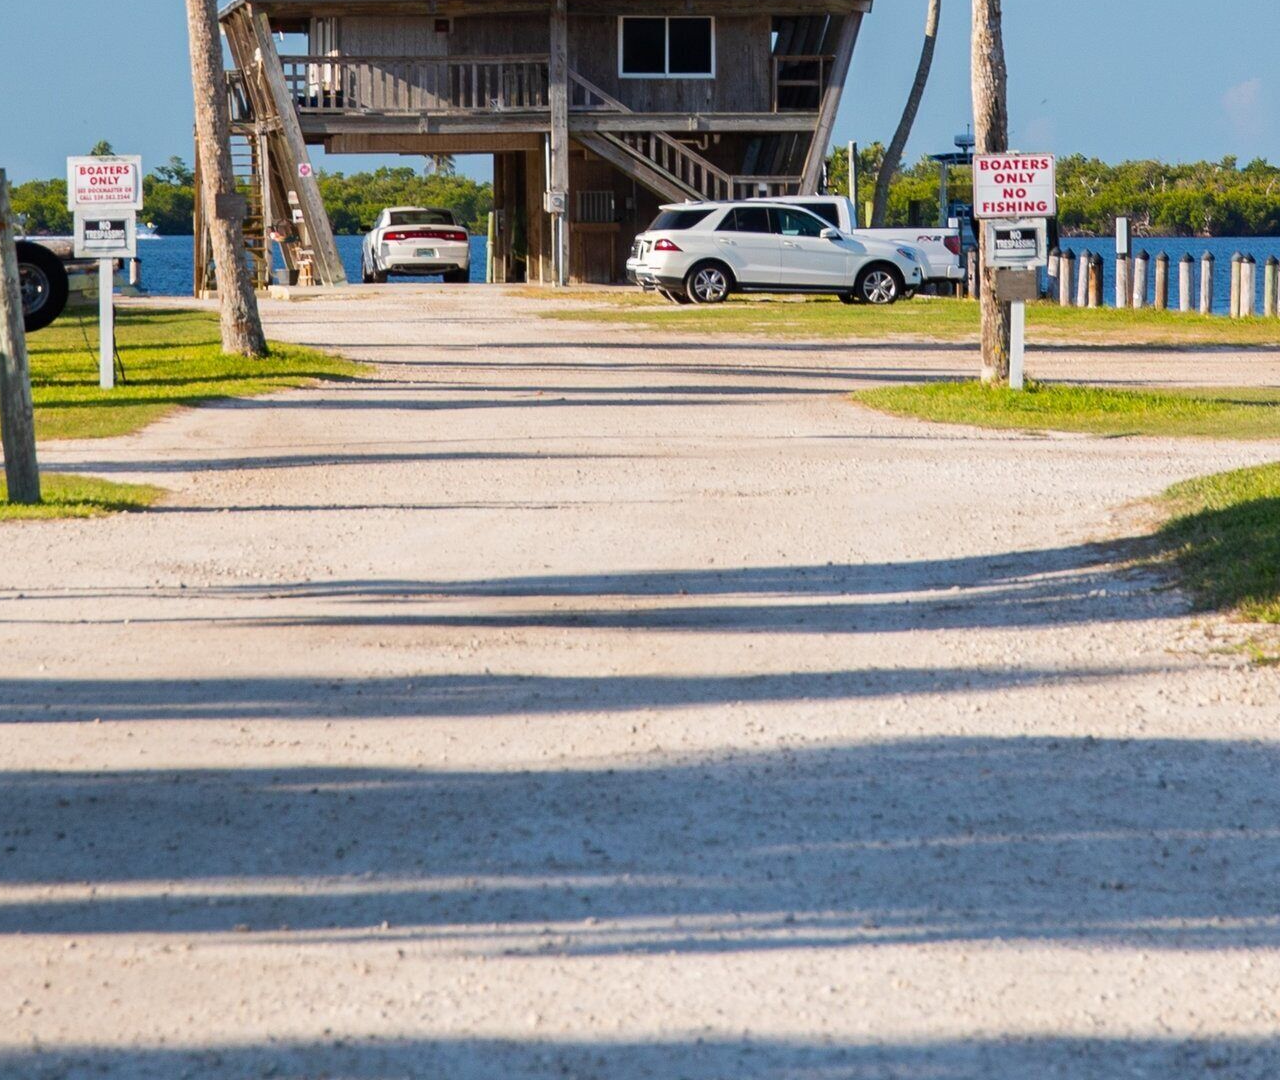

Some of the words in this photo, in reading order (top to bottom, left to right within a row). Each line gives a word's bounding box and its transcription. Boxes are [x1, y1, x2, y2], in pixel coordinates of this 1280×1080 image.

[980, 159, 1049, 170] BOATERS
[80, 166, 129, 175] BOATERS
[90, 176, 120, 185] ONLY
[994, 173, 1035, 184] ONLY
[1003, 188, 1026, 199] NO
[983, 201, 1048, 212] FISHING
[99, 221, 111, 230] NO
[85, 230, 124, 239] TRESPASSING
[1010, 230, 1022, 240] NO
[996, 239, 1035, 248] TRESPASSING
